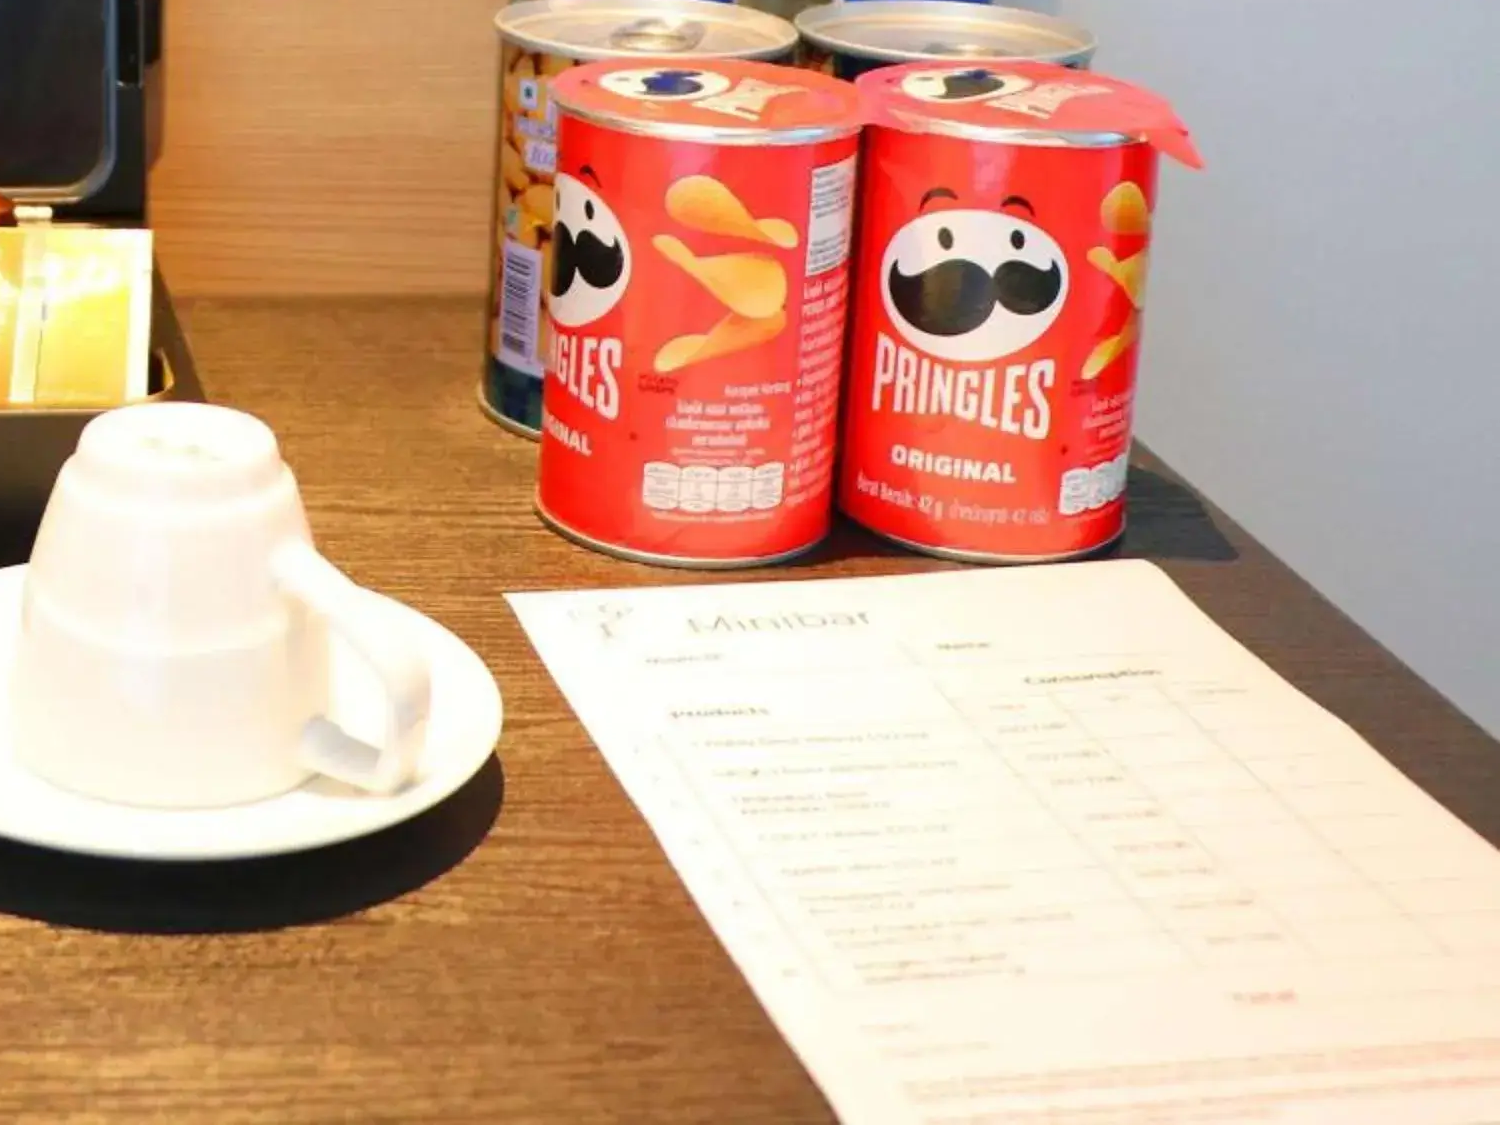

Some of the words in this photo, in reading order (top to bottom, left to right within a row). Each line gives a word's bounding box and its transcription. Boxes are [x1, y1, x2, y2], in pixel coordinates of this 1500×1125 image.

[549, 332, 623, 421] GLES
[872, 331, 1055, 440] PRINGLES
[891, 444, 1016, 484] ORIGINAL
[686, 611, 871, 635] Minibar
